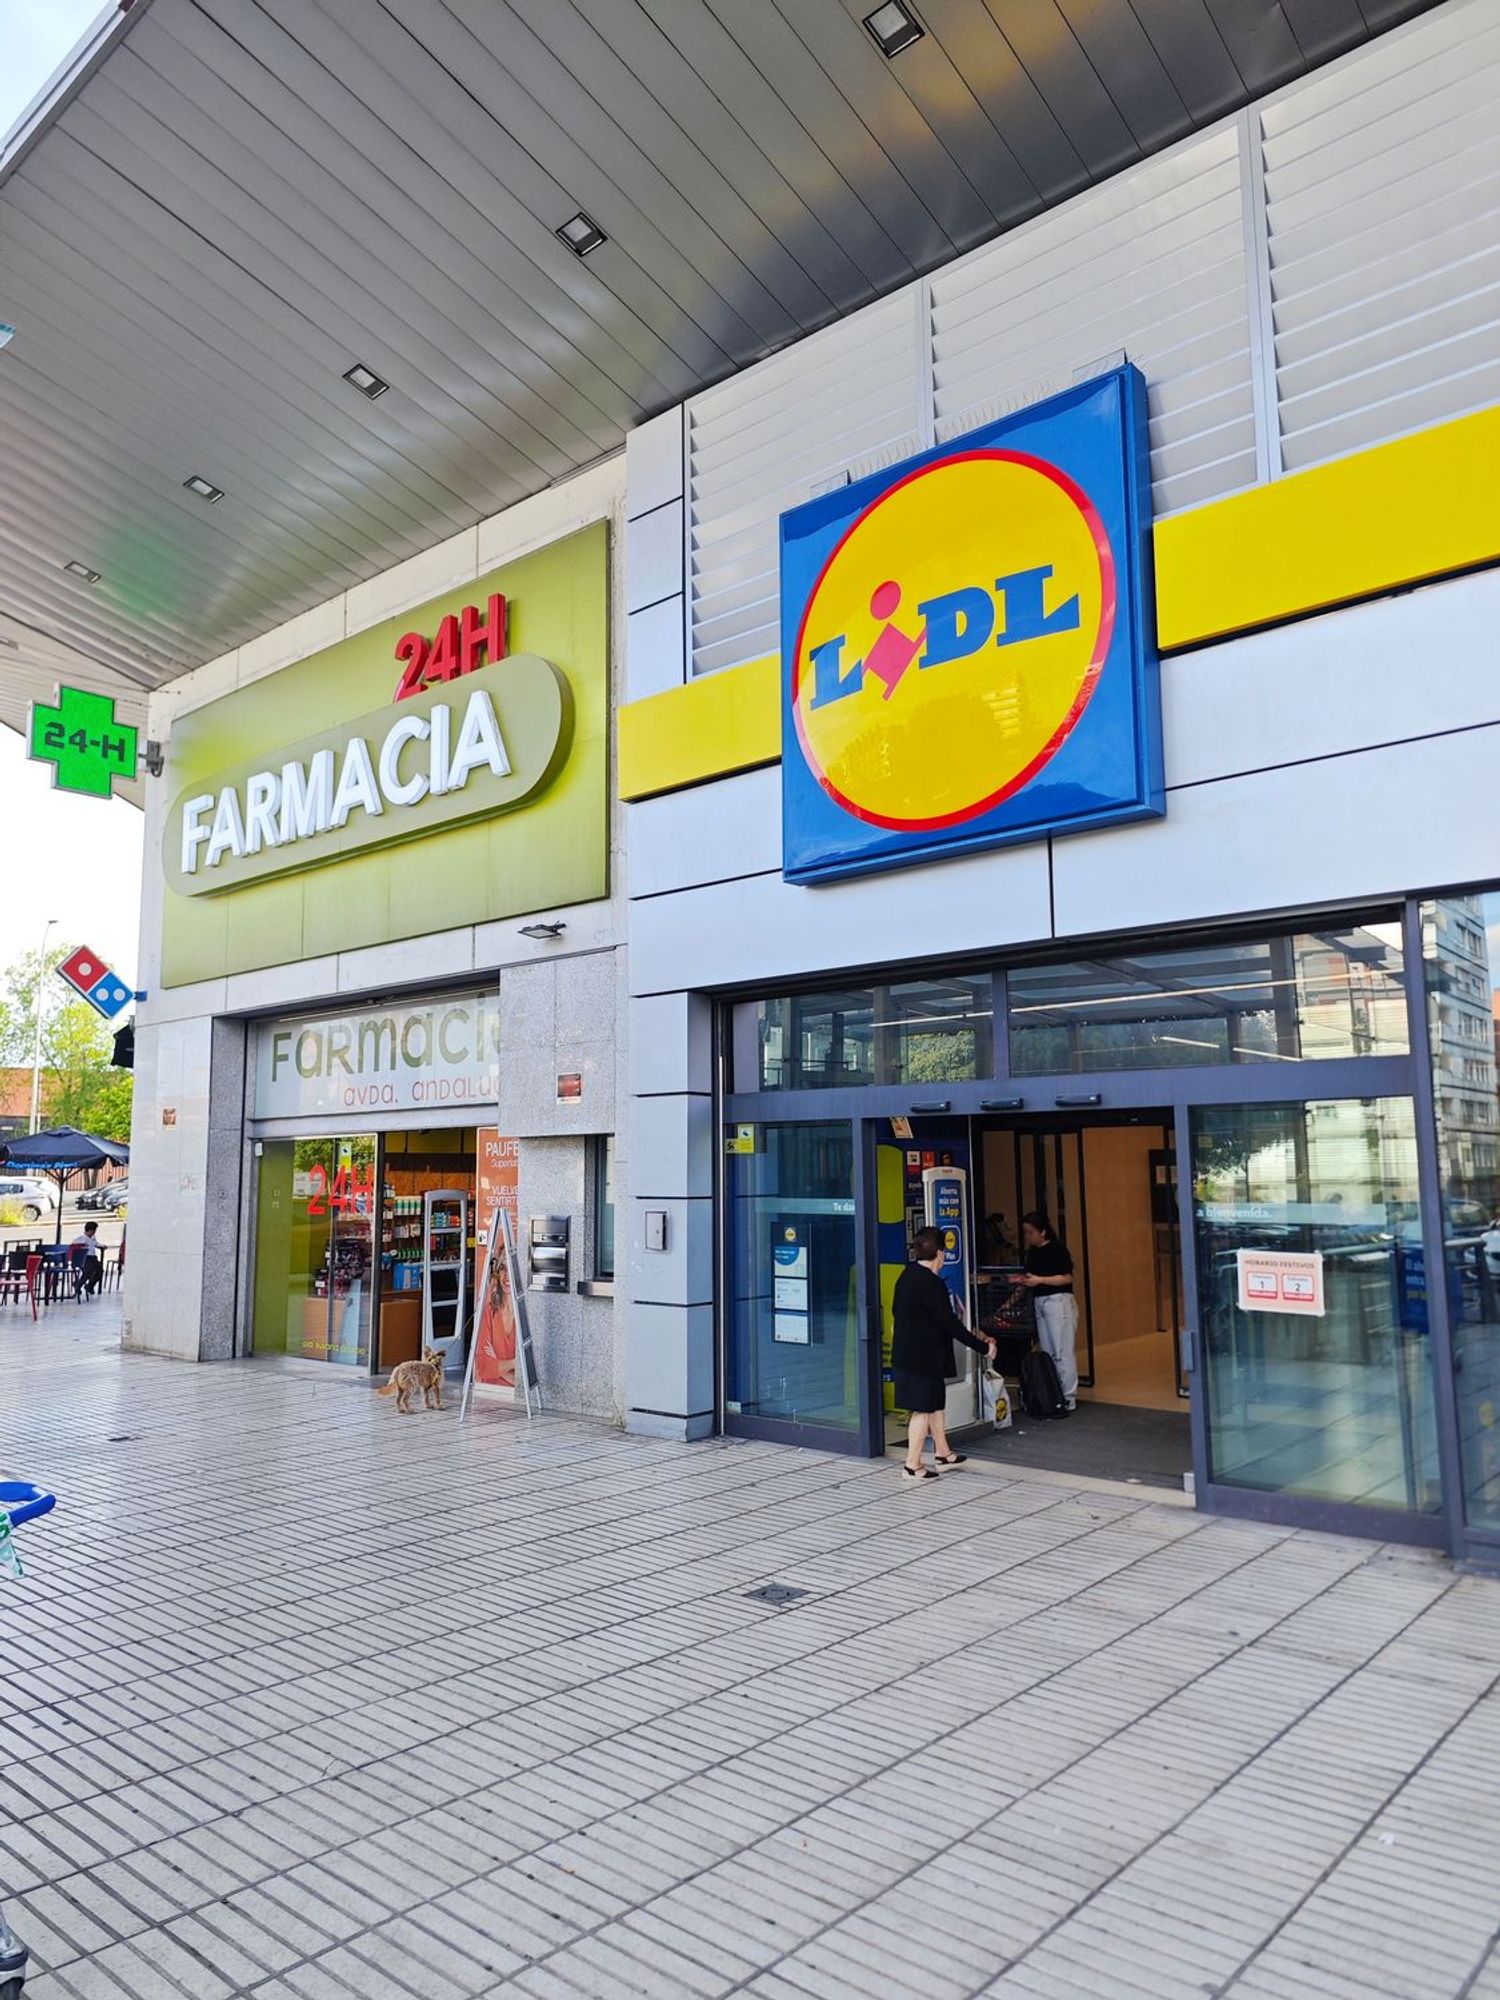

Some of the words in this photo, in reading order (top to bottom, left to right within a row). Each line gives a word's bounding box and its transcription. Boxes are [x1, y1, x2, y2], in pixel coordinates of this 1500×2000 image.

[393, 592, 507, 703] 24H
[44, 721, 125, 763] 24-H
[181, 689, 512, 875] FARMACIA
[307, 1163, 373, 1214] 24H
